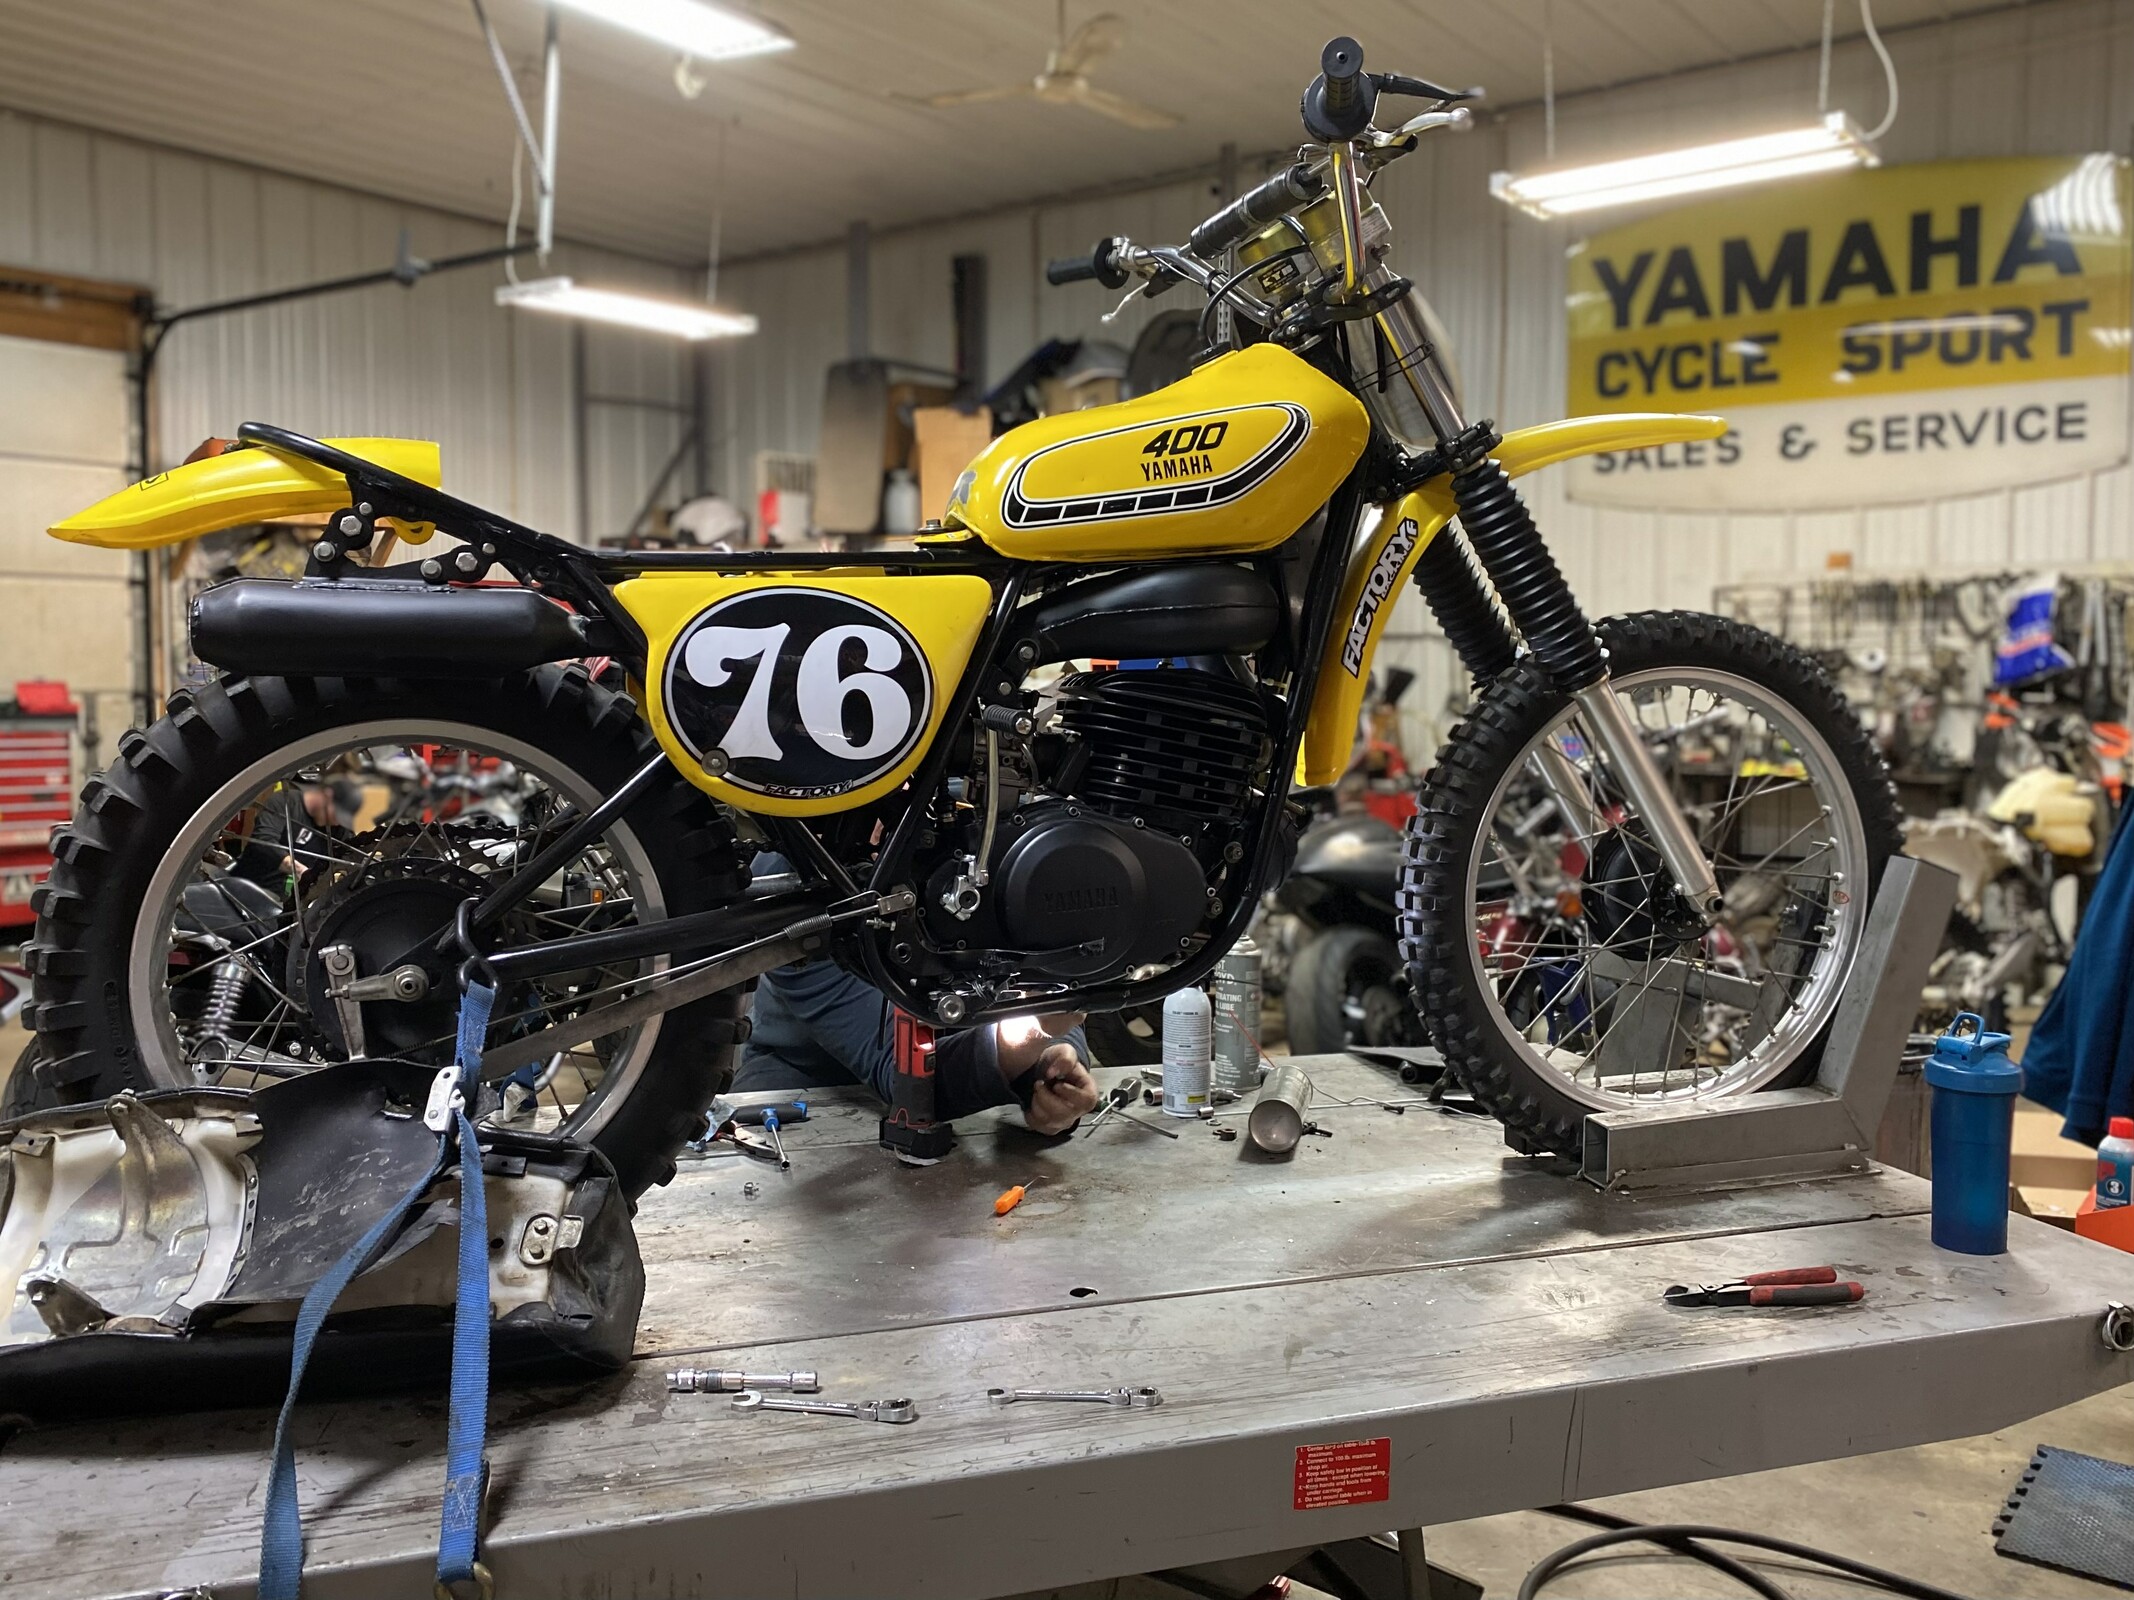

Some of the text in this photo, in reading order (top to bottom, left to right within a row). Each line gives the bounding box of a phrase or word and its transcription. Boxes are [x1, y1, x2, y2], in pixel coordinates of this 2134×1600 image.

[1592, 193, 2083, 330] YAMAHA
[1595, 300, 2090, 401] CYCLE SPORT
[1142, 420, 1229, 458] 400
[1594, 402, 2089, 474] SALES & SERVICE
[1140, 454, 1213, 482] YAMAHA
[1342, 518, 1412, 677] FACTORY
[685, 622, 911, 761] 76
[764, 780, 850, 797] FACTORY
[1044, 886, 1119, 914] YAMAHA
[2110, 1181, 2120, 1194] 3
